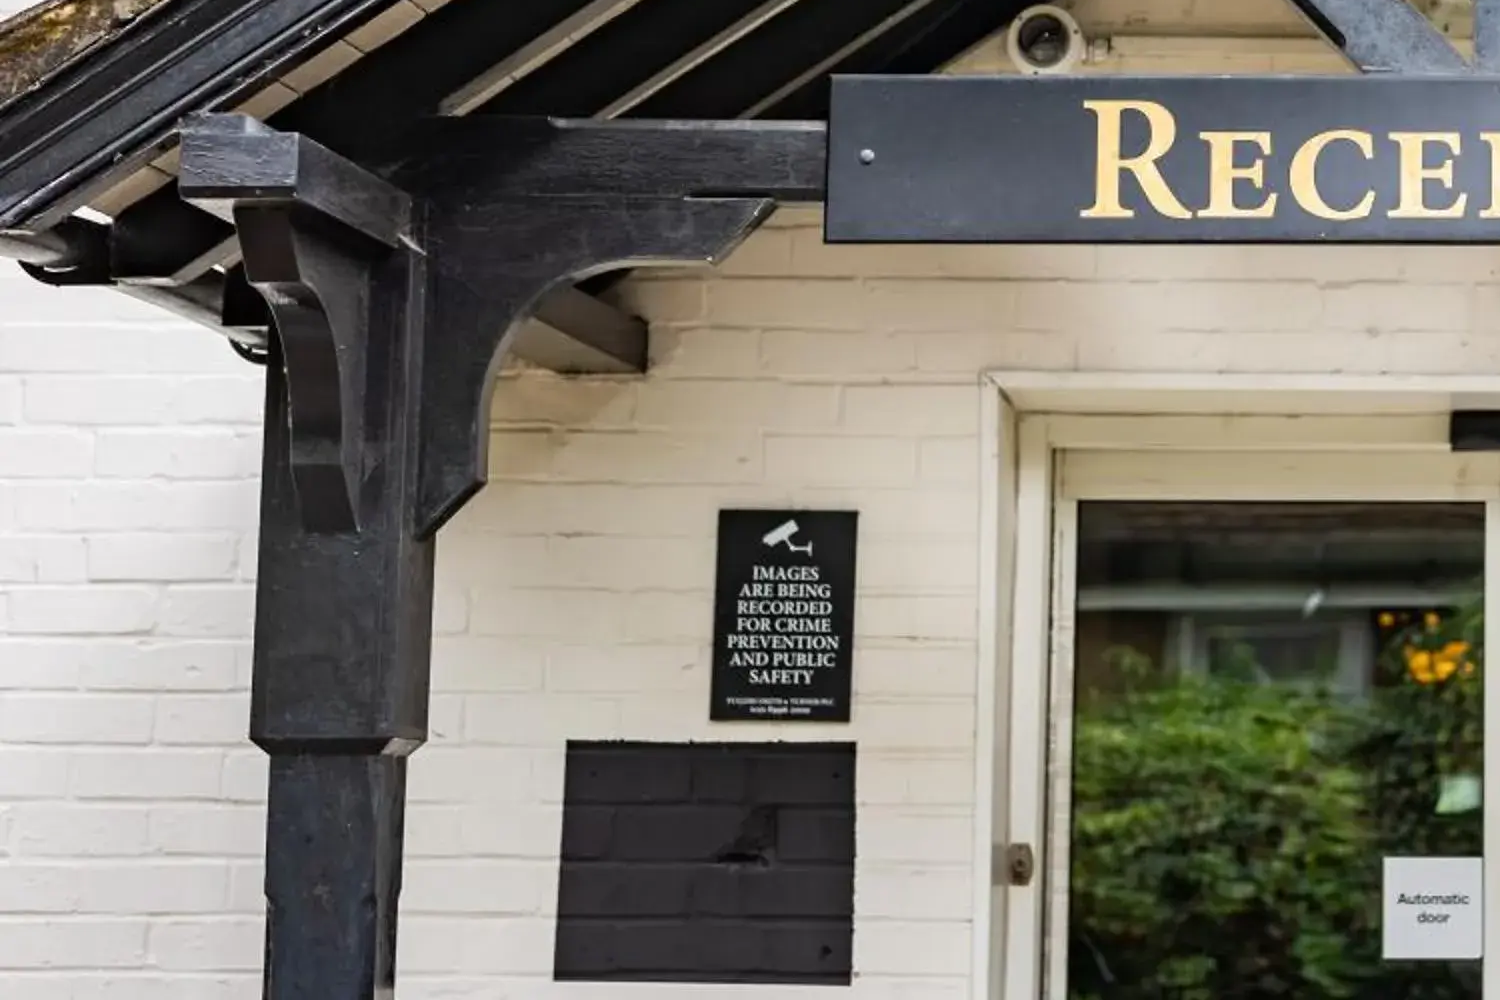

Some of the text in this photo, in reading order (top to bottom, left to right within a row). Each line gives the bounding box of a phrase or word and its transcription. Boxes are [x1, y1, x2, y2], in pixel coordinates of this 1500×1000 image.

[753, 565, 820, 581] IMAGES
[739, 583, 831, 599] ARE BEING
[737, 600, 833, 615] RECORDED
[737, 617, 832, 633] FOR CRIME
[727, 634, 840, 650] PREVENTION
[729, 651, 836, 667] AND PUBLIC
[749, 669, 814, 685] SAFETY
[1396, 892, 1470, 905] Automatic
[1416, 912, 1451, 924] door
